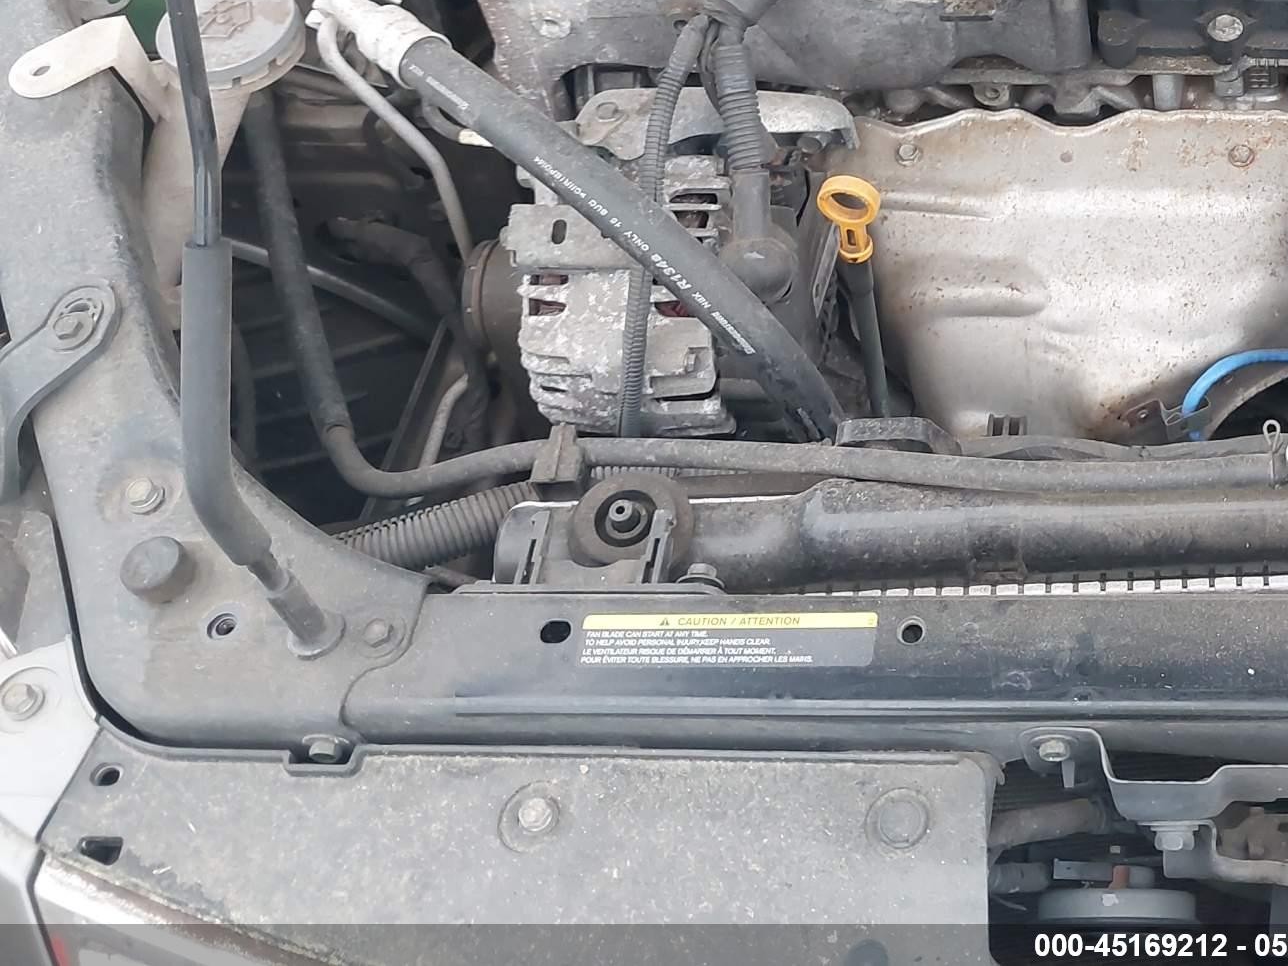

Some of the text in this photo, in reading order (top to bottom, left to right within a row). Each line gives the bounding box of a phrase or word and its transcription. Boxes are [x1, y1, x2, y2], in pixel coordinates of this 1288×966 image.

[623, 231, 650, 251] ONLY
[678, 617, 728, 626] CAUTION
[739, 617, 800, 626] ATTENTION
[580, 656, 600, 664] POUR
[602, 655, 627, 664] ÉVITER
[628, 656, 650, 664] TOUTE
[690, 656, 701, 664] NE
[702, 656, 716, 664] PAS
[717, 656, 728, 664] EN
[728, 656, 773, 664] APPROCHER
[774, 656, 788, 664] LES
